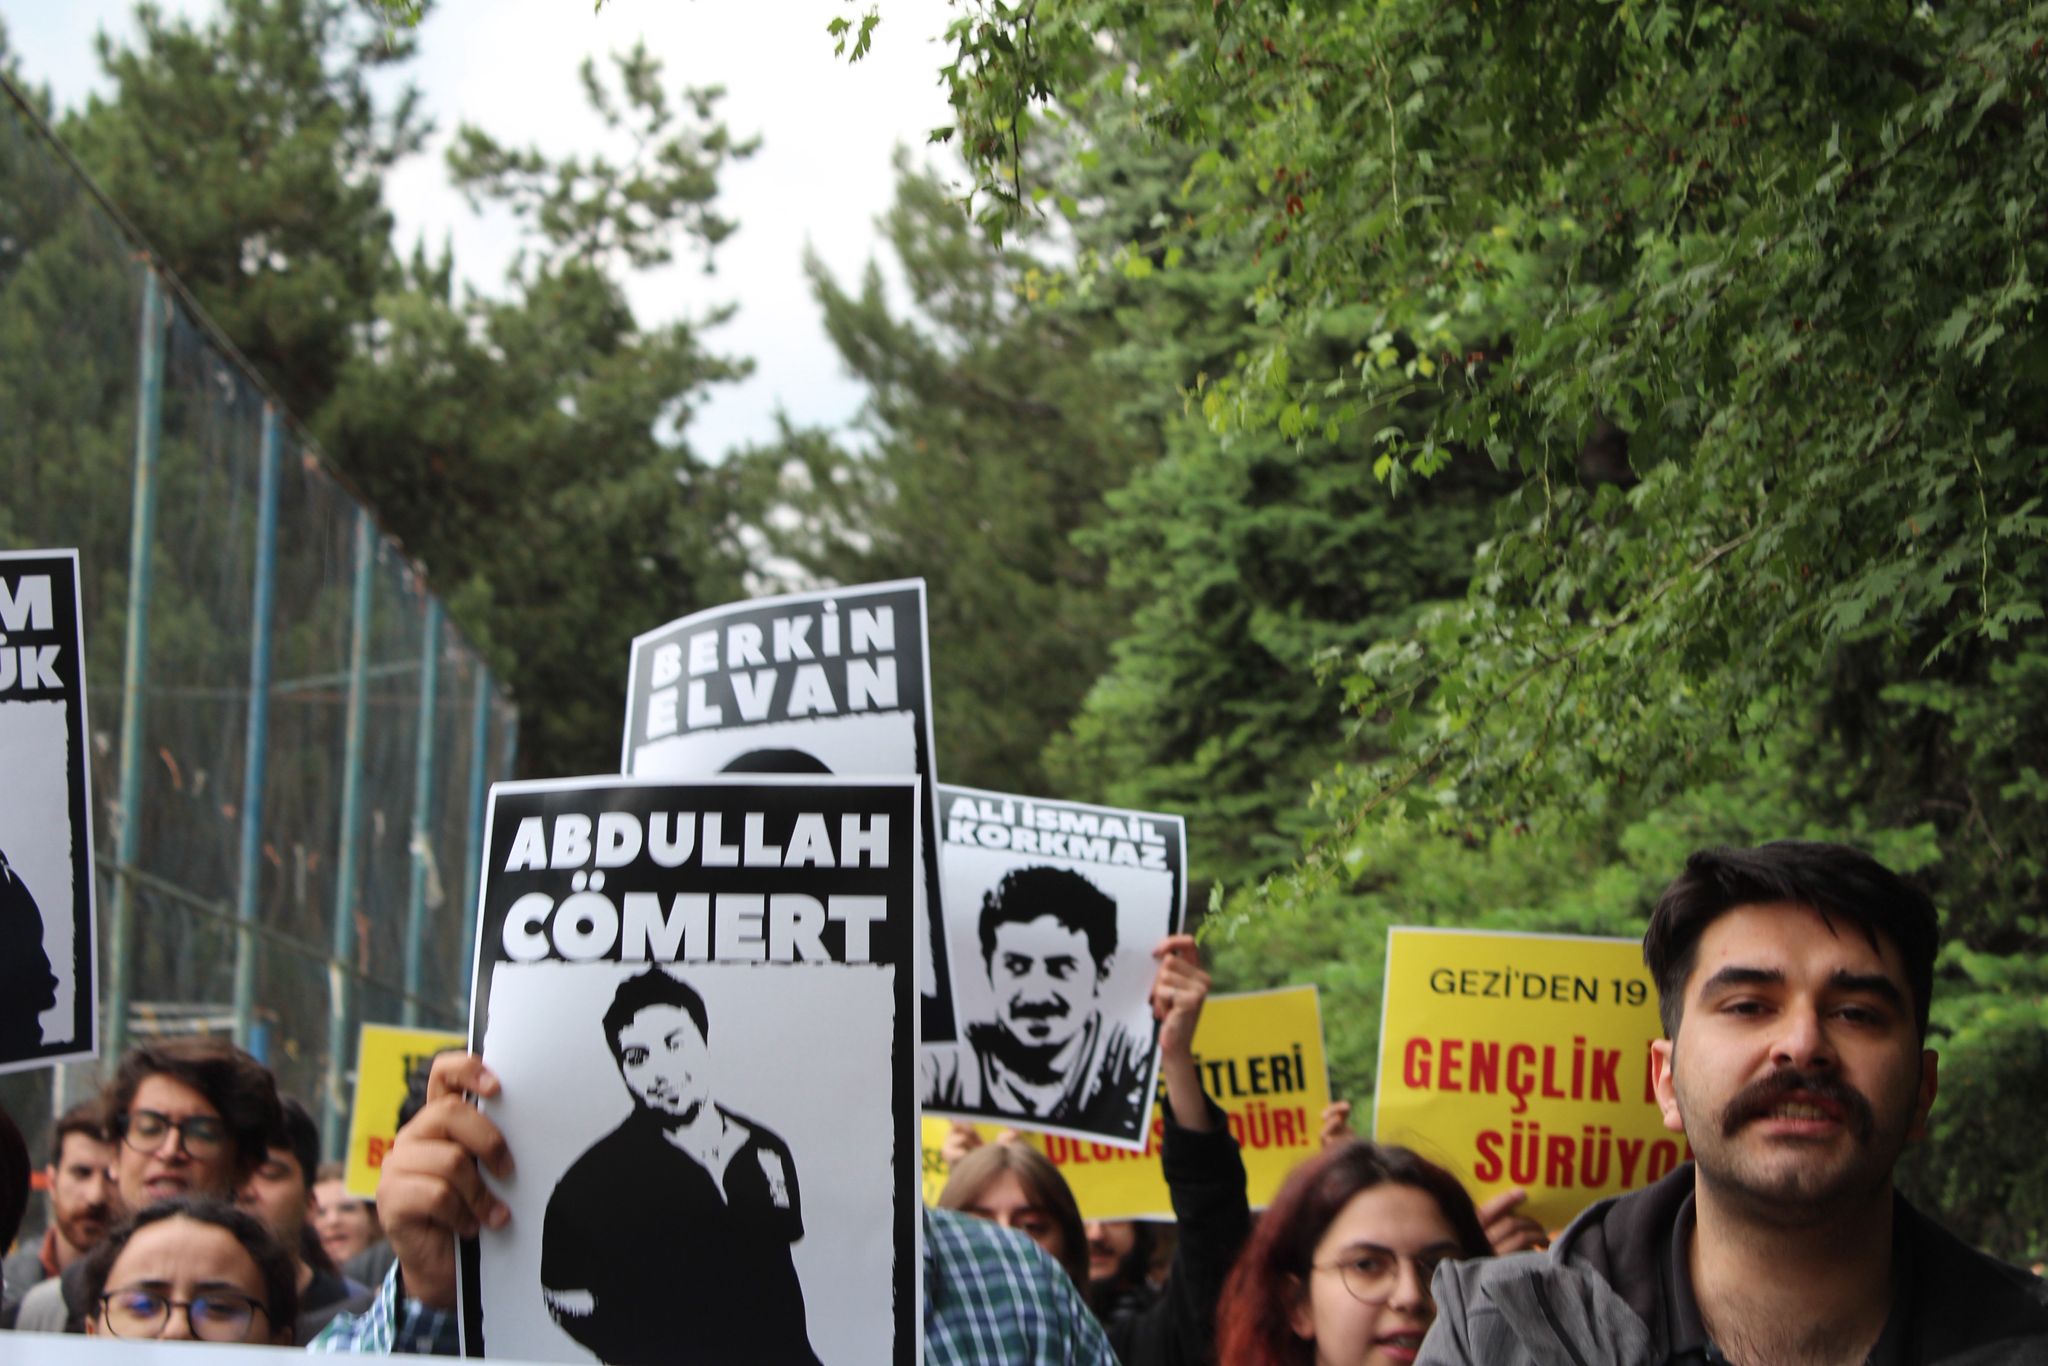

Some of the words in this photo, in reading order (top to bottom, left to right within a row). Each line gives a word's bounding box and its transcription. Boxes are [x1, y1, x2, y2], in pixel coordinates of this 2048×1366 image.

[652, 600, 895, 688] BERKİN
[647, 656, 898, 739] ELVAN
[504, 811, 891, 871] ABDULLAH
[947, 819, 1168, 869] KORKMAZ
[950, 797, 1015, 826] ALİ
[1022, 801, 1166, 845] İSMAİL
[502, 870, 887, 963] CÖMERT
[1430, 965, 1598, 1004] GEZİ'DEN
[1611, 979, 1648, 1007] 19
[1403, 1035, 1621, 1114] GENÇLİK
[1474, 1121, 1694, 1188] SÜRÜYO
